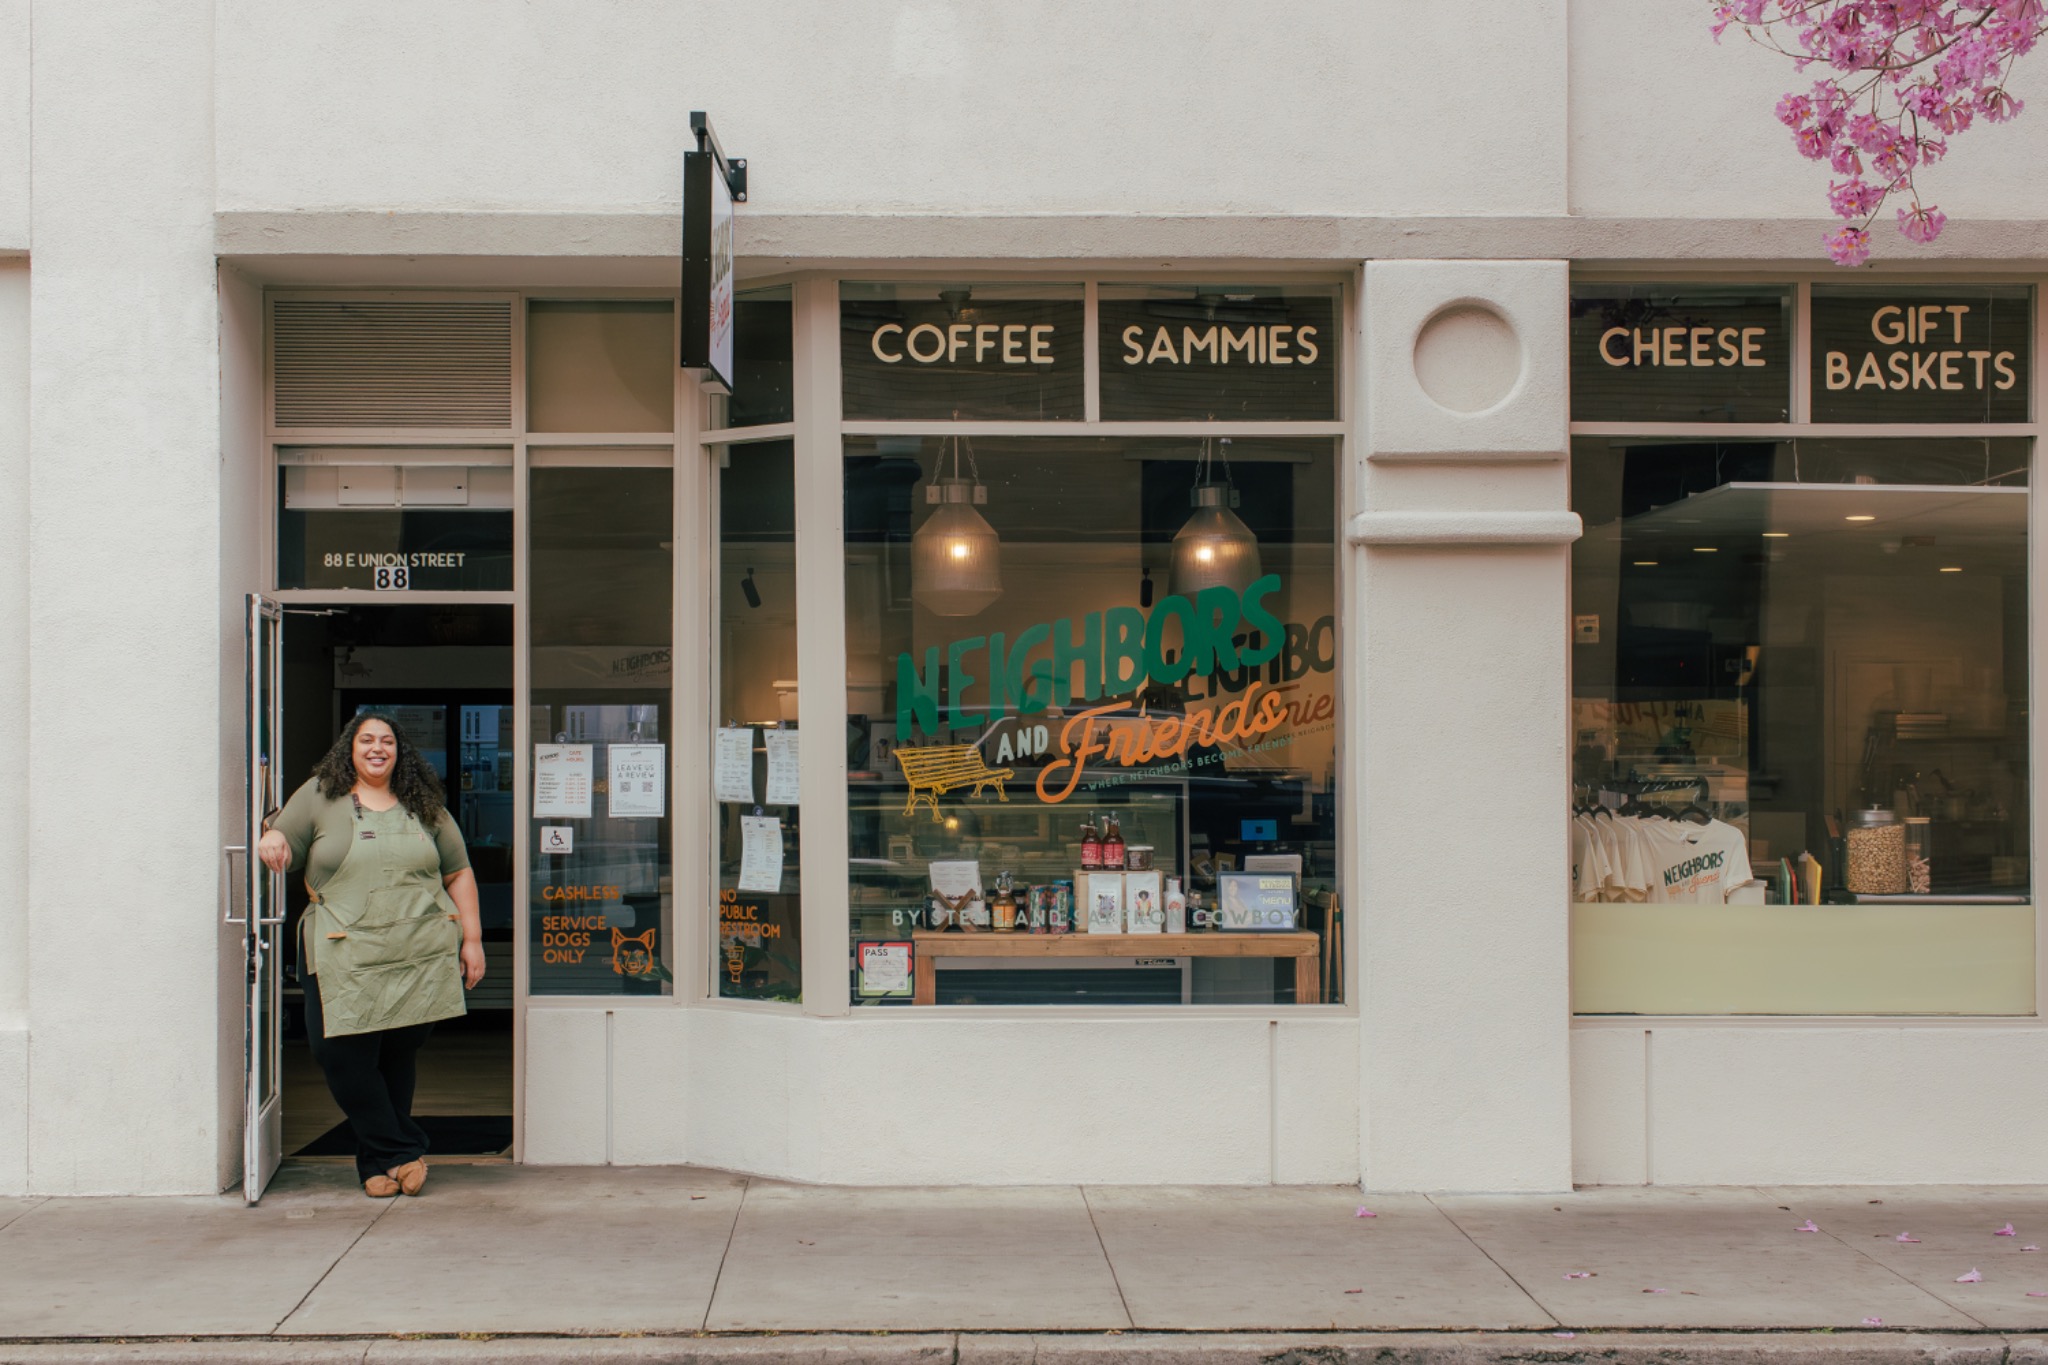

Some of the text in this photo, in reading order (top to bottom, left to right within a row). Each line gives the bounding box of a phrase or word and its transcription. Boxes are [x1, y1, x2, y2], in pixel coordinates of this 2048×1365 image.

[1871, 305, 1970, 345] GIFT
[871, 323, 1055, 363] COFFEE
[1123, 324, 1319, 365] SAMMIES
[1599, 327, 1767, 367] CHEESE
[1826, 351, 2016, 390] BASKETS
[324, 553, 465, 567] 88 E UNION STREET
[376, 568, 408, 589] 88
[896, 573, 1286, 742] NEIGHBORS
[996, 680, 1288, 804] AND Friends
[1129, 759, 1193, 782] NEIGHBORS
[1196, 749, 1243, 768] BECOME
[1663, 850, 1725, 886] NEIGHBORS
[542, 885, 620, 900] CASHLESS
[720, 888, 737, 903] NO
[720, 905, 758, 920] PUBLIC
[892, 910, 920, 926] BY
[931, 909, 1004, 926] STEMS
[1015, 910, 1069, 926] AND
[1193, 909, 1300, 926] COWBOY
[542, 916, 607, 931] SERVICE
[720, 921, 780, 938] RESTROOM
[542, 932, 591, 947] DOGS
[543, 949, 586, 964] ONLY
